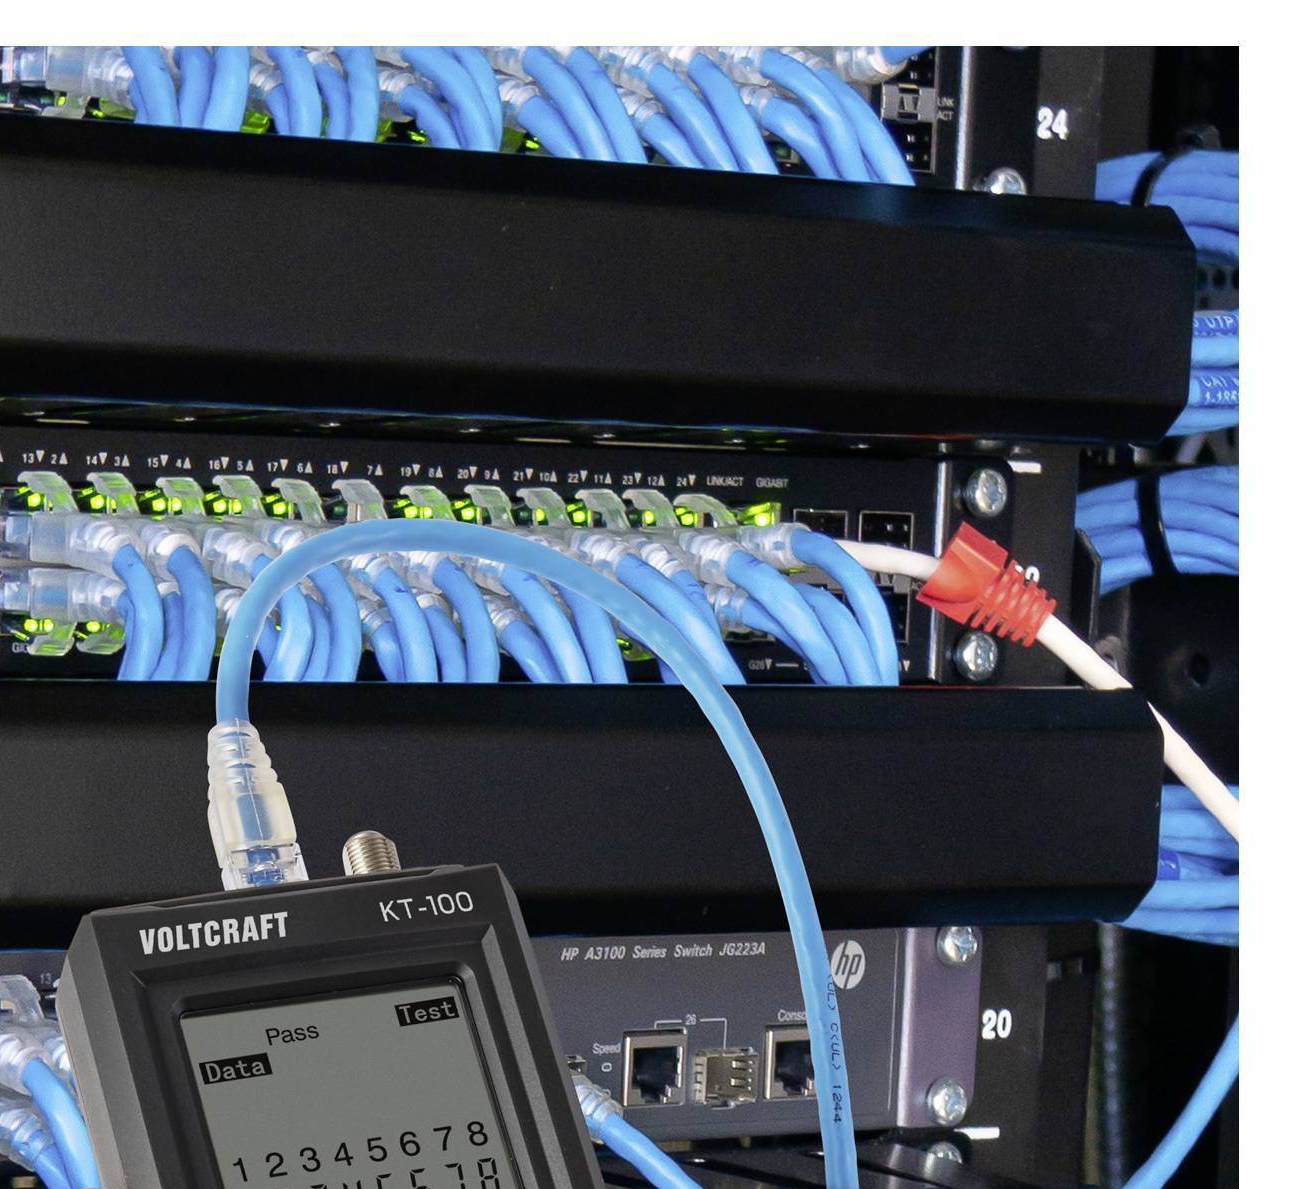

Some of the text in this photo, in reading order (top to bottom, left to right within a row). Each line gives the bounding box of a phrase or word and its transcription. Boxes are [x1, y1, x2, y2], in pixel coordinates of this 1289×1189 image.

[1037, 106, 1070, 140] 24
[22, 453, 35, 464] 13
[86, 455, 98, 466] 14
[147, 457, 159, 468] 15
[209, 459, 220, 470] 16
[267, 462, 278, 472] 17
[327, 464, 338, 474] 18
[400, 467, 411, 477] 19
[457, 469, 469, 480] 20
[512, 471, 524, 482] 21
[539, 472, 550, 482] 10
[567, 473, 579, 483] 22
[594, 474, 604, 483] 11
[622, 475, 633, 485] 23
[647, 476, 660, 486] 12
[676, 477, 688, 487] 24
[756, 477, 789, 488] GIGABIT
[379, 891, 474, 922] KT-100
[139, 911, 288, 955] VOLTCRAFT
[561, 942, 766, 961] HP A3100 Series Switch JG223A
[832, 940, 864, 989] hp
[398, 1001, 456, 1023] Test
[685, 1014, 697, 1025] 26
[982, 1008, 1012, 1040] 20
[265, 1024, 320, 1046] Pass
[592, 1042, 621, 1055] Speed
[205, 1060, 266, 1081] Data
[232, 1121, 488, 1182] 1 2 3 4 5 6 7 8
